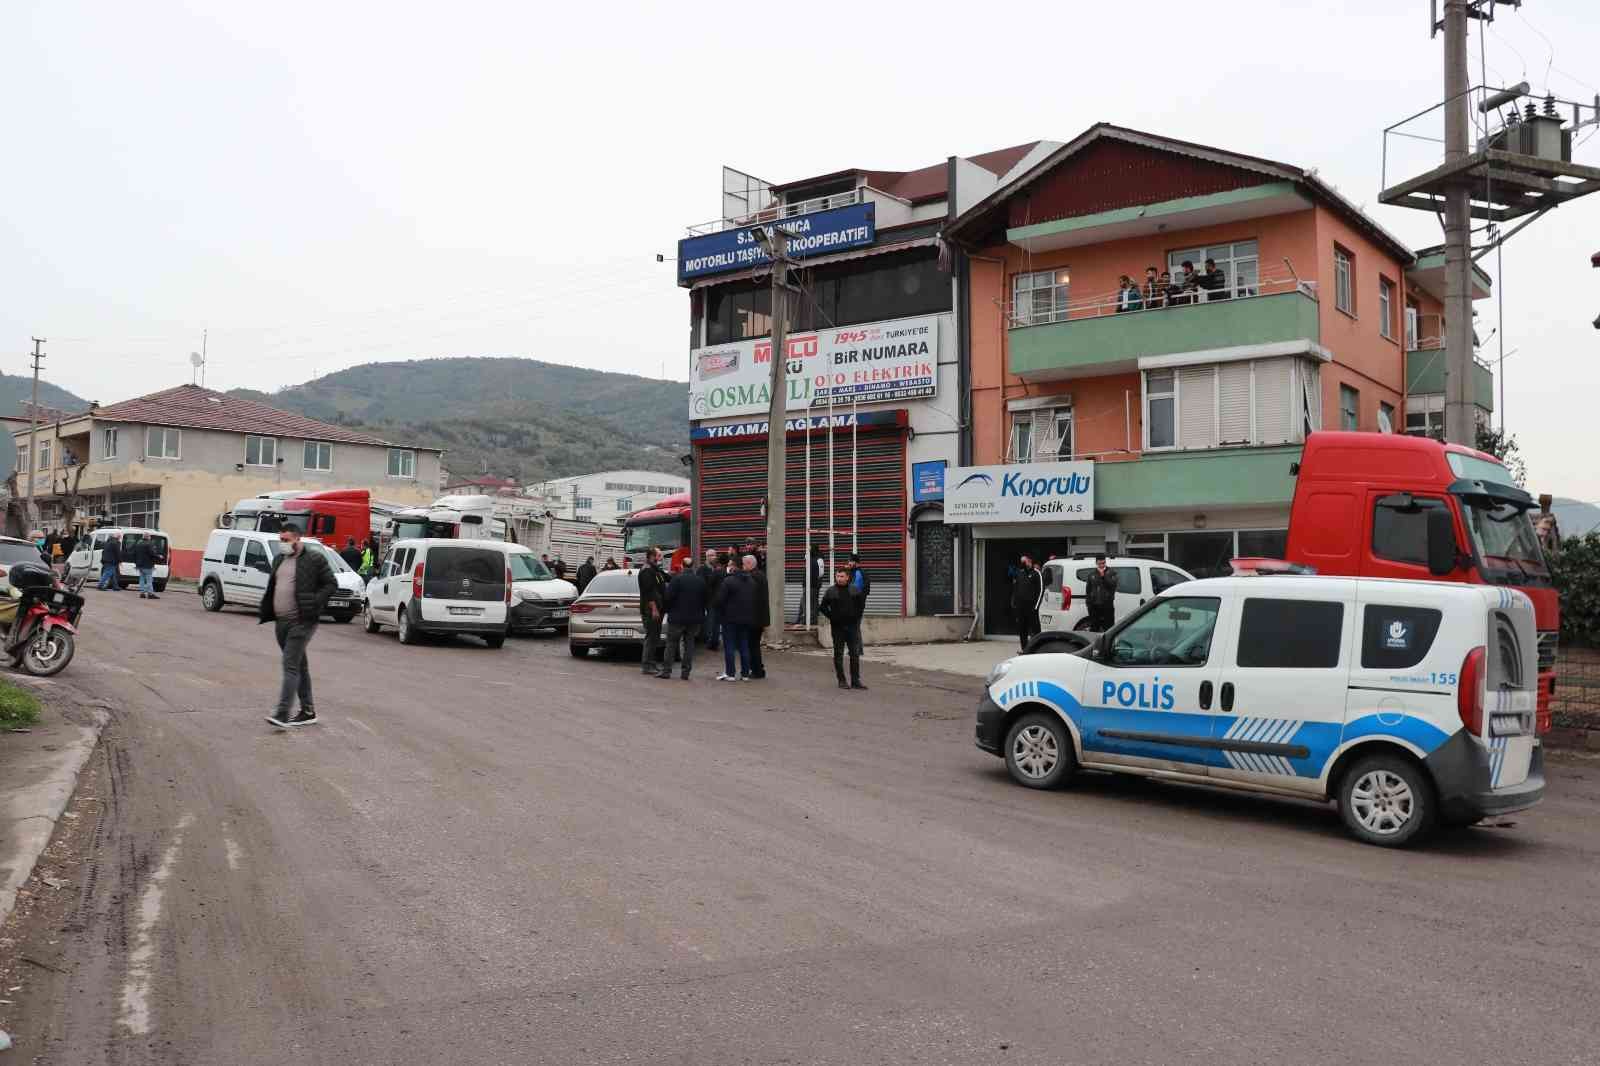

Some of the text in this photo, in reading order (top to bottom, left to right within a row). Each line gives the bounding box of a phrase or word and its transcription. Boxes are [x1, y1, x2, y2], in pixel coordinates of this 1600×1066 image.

[685, 251, 735, 273] MOTORLU
[834, 329, 868, 345] 1945
[753, 336, 818, 364] MLU
[862, 341, 929, 361] NUMARA
[710, 378, 812, 409] OSMALI
[1020, 500, 1064, 517] lojistik
[1431, 673, 1456, 685] 155
[1103, 676, 1174, 710] POLİS
